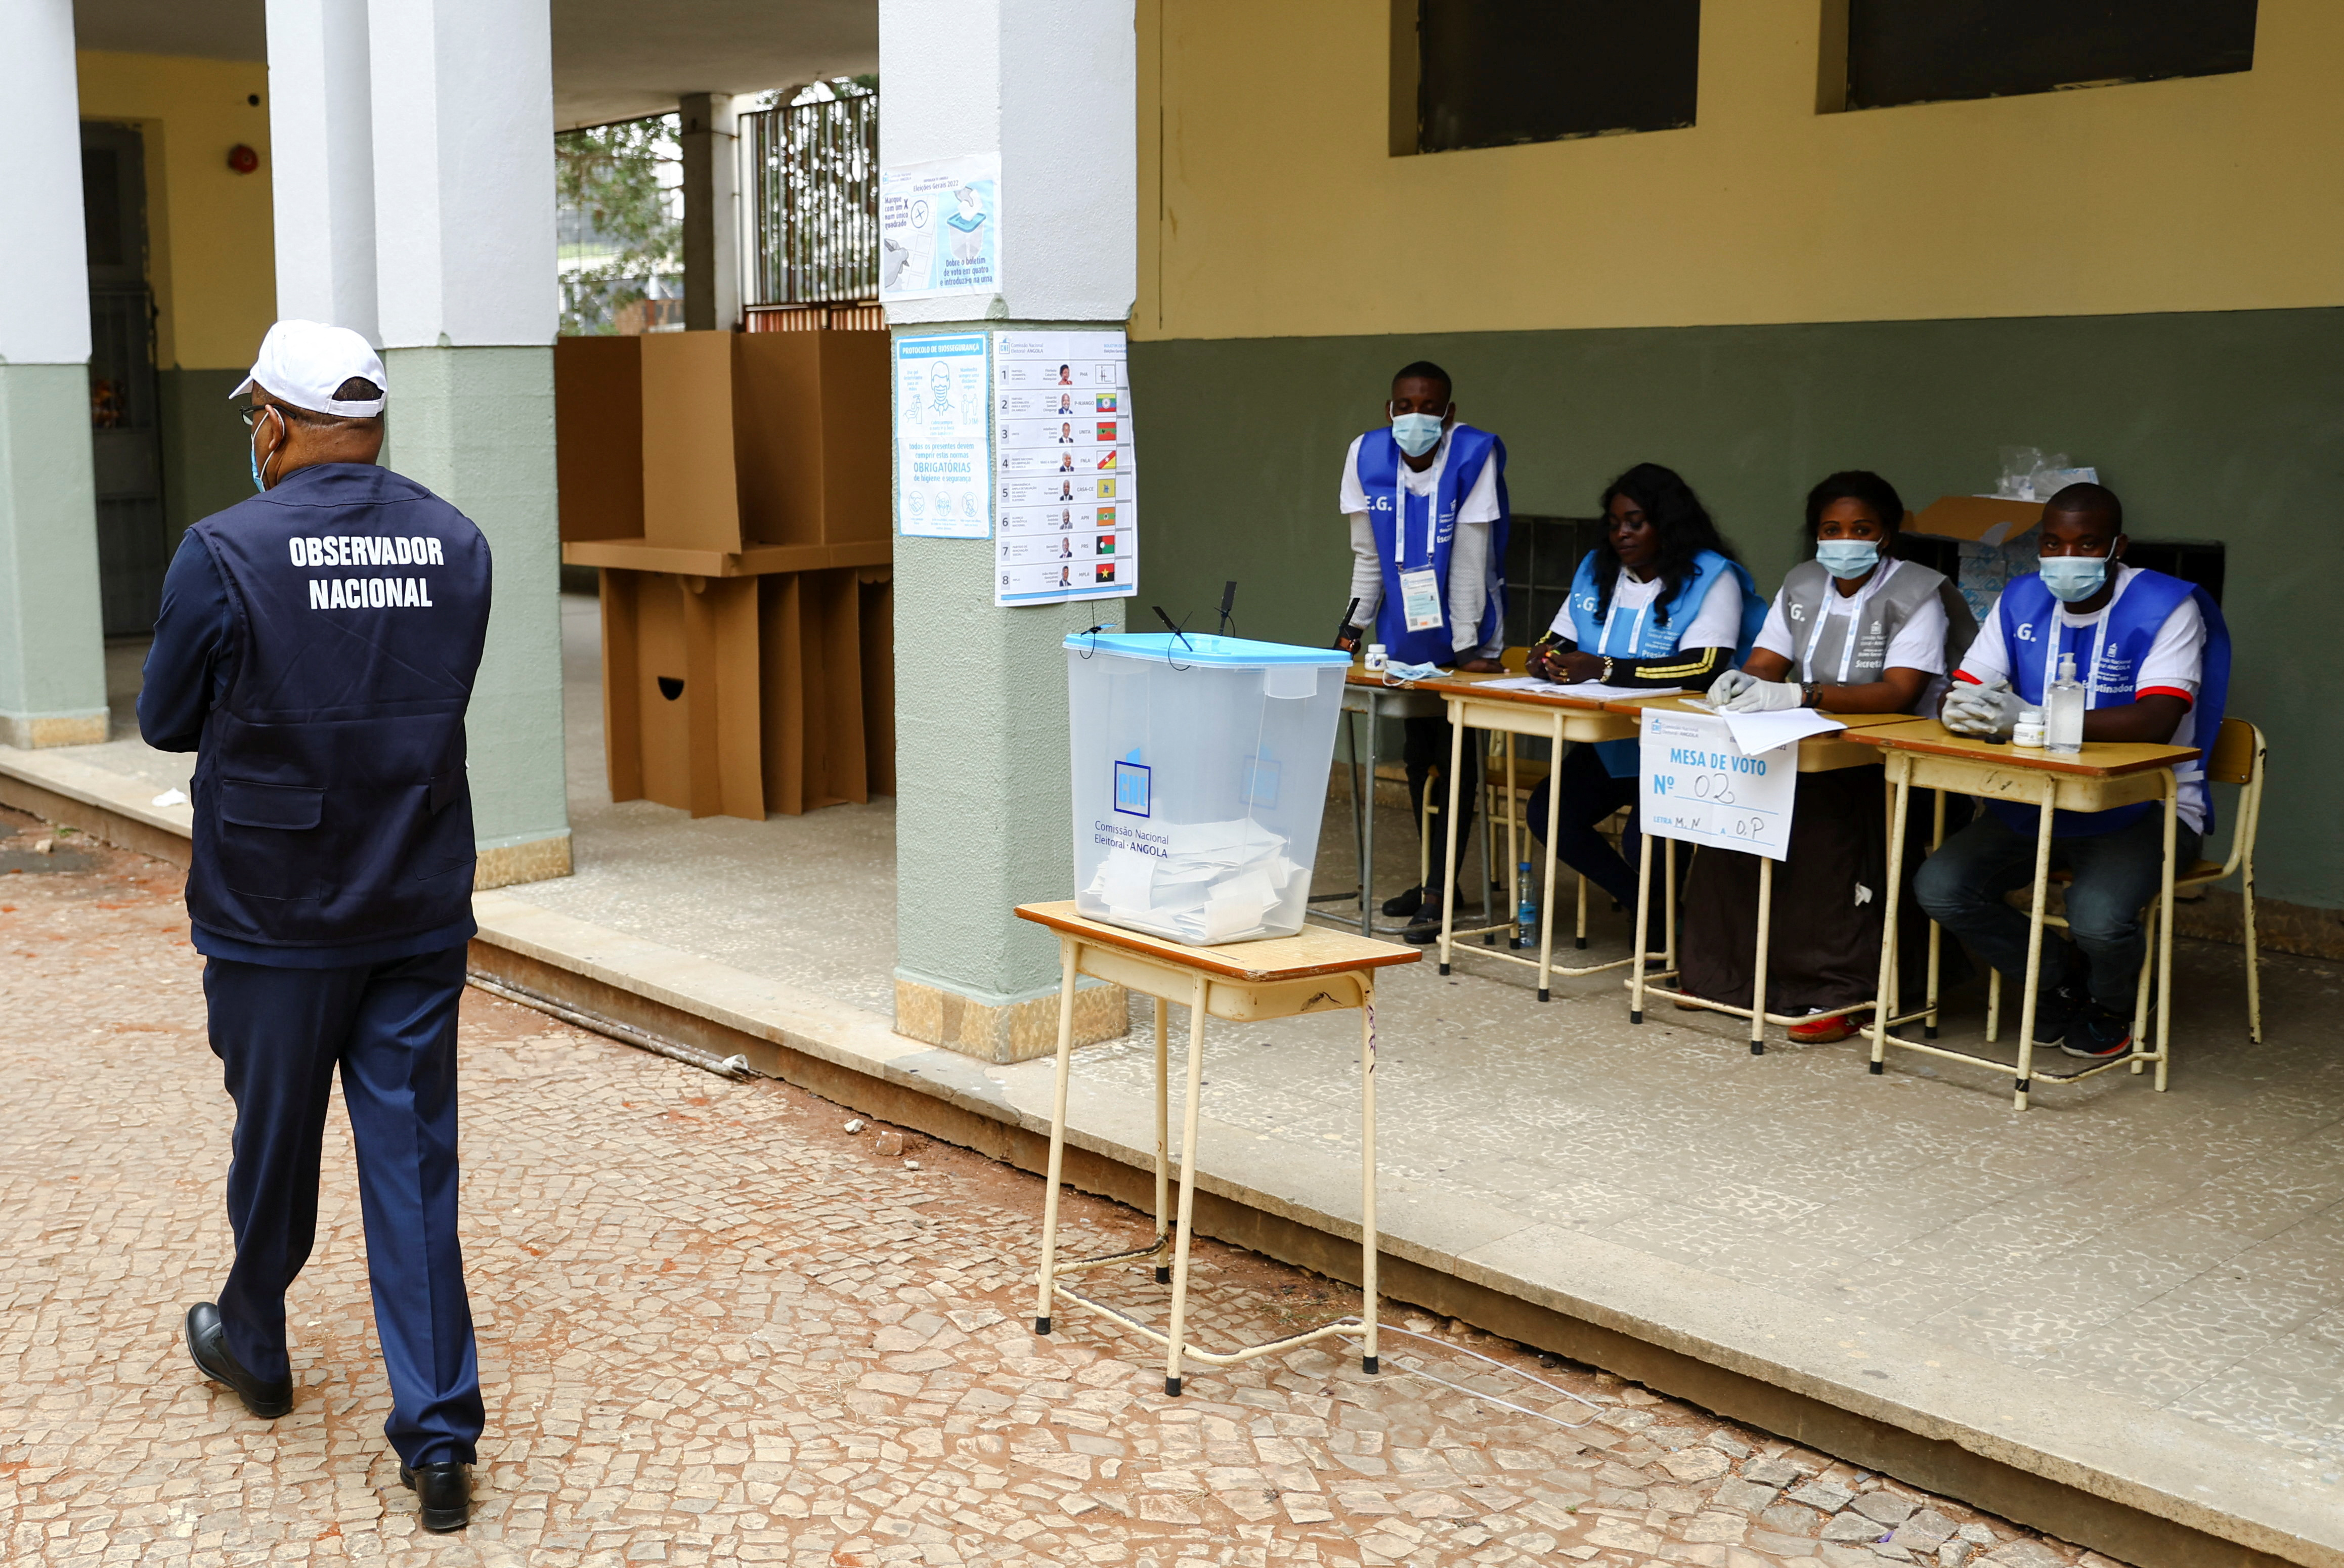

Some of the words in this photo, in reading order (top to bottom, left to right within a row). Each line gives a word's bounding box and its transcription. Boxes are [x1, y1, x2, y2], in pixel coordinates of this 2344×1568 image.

[914, 184, 931, 192] Eleições
[885, 196, 901, 205] Marque
[904, 198, 908, 209] X
[885, 220, 906, 230] quadrado
[946, 258, 960, 267] Dobre
[966, 256, 986, 265] boletim
[943, 268, 949, 277] de
[972, 266, 988, 276] quatro
[944, 277, 971, 286] introduza-o
[938, 343, 979, 353] BIOSSEGURANÇA
[1002, 370, 1006, 379] 1
[1002, 400, 1008, 409] 2
[1002, 429, 1008, 439] 3
[932, 443, 956, 451] presentes
[915, 451, 935, 460] cumprir
[914, 460, 971, 472] OBRIGATÓRIAS
[1003, 459, 1008, 468] 4
[921, 474, 940, 483] higiene
[1003, 489, 1008, 497] 5
[1003, 517, 1008, 527] 6
[289, 535, 445, 567] OBSERVADOR
[1003, 547, 1008, 555] 7
[1003, 576, 1009, 585] 8
[309, 578, 433, 610] NACIONAL
[1670, 748, 1706, 767] MESA
[1711, 754, 1727, 770] DE
[1731, 756, 1766, 776] VOTO
[1654, 774, 1674, 795] Nº
[1118, 773, 1147, 807] CNE
[1654, 816, 1672, 824] LETRA
[1095, 820, 1133, 837] Comissão
[1135, 829, 1169, 845] Nacional
[1095, 834, 1125, 849] Eleitoral
[1130, 842, 1167, 858] ANGOLA
